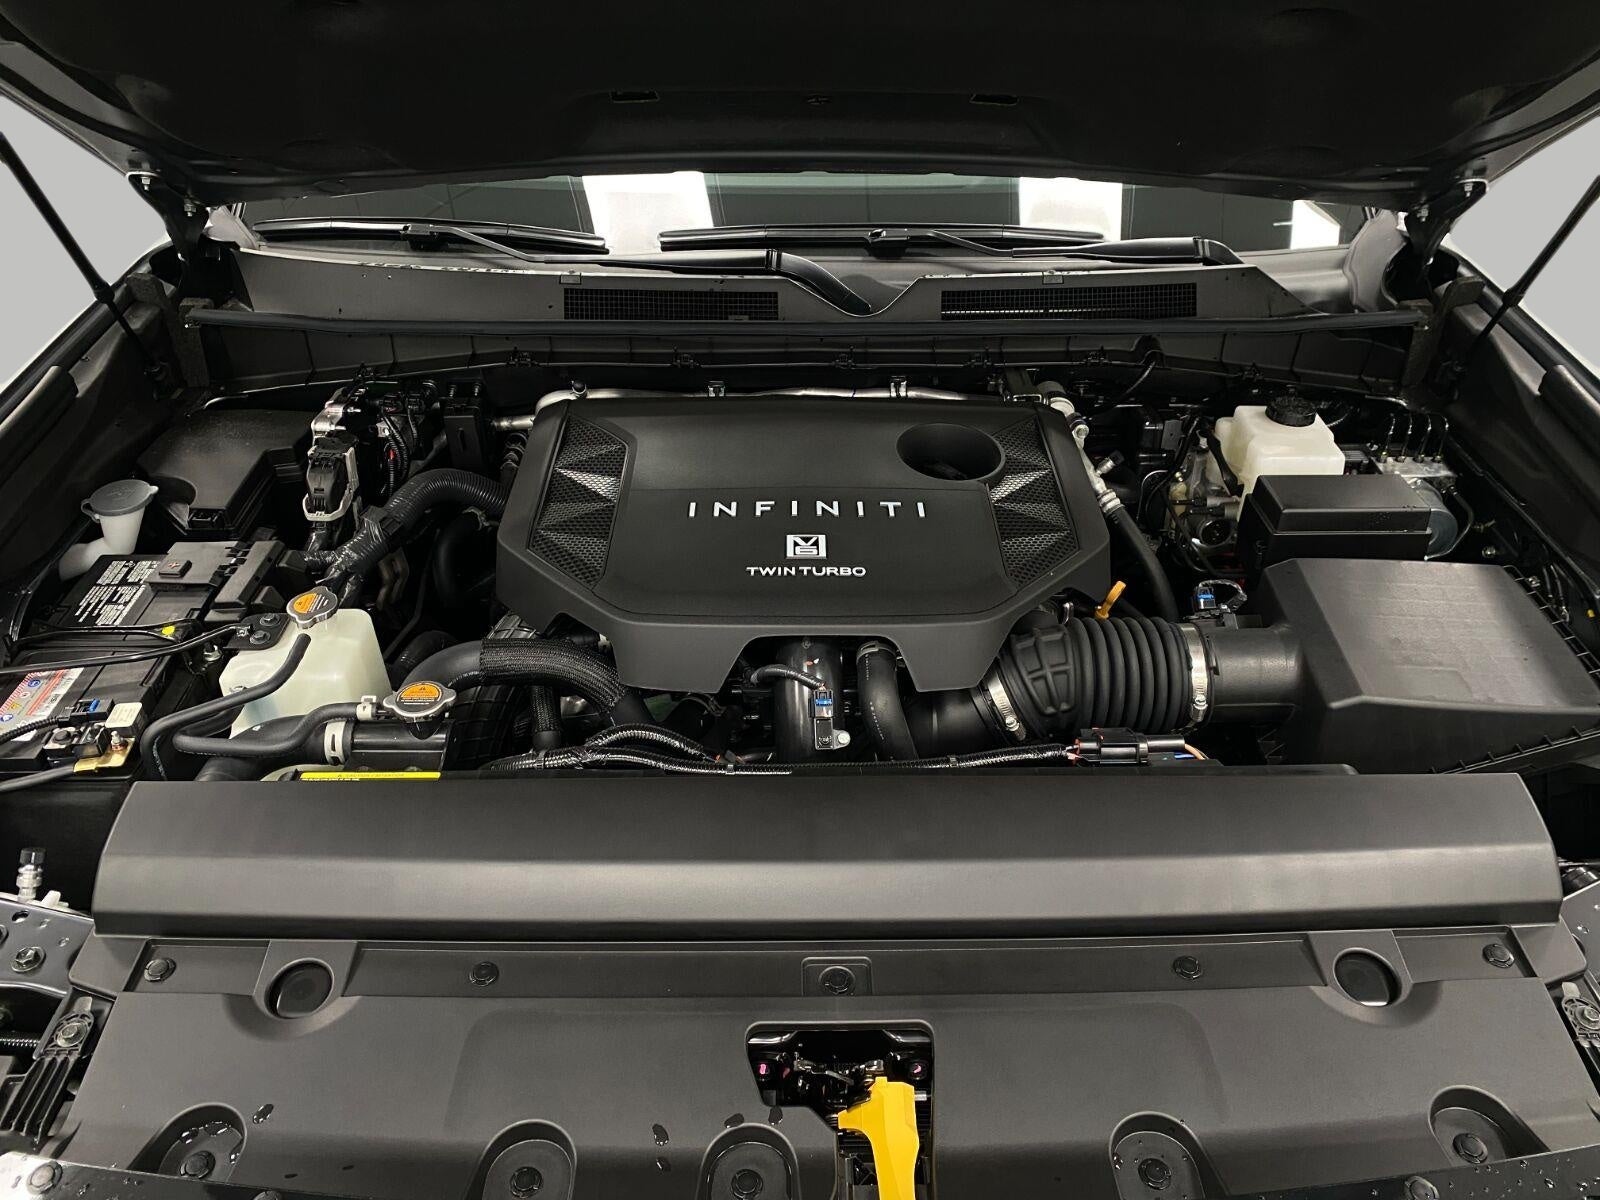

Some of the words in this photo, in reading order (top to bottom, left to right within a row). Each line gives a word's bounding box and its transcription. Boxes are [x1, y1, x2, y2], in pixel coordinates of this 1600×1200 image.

[688, 501, 926, 518] INFINITI
[746, 566, 796, 577] TWIN
[799, 566, 867, 577] TURBO
